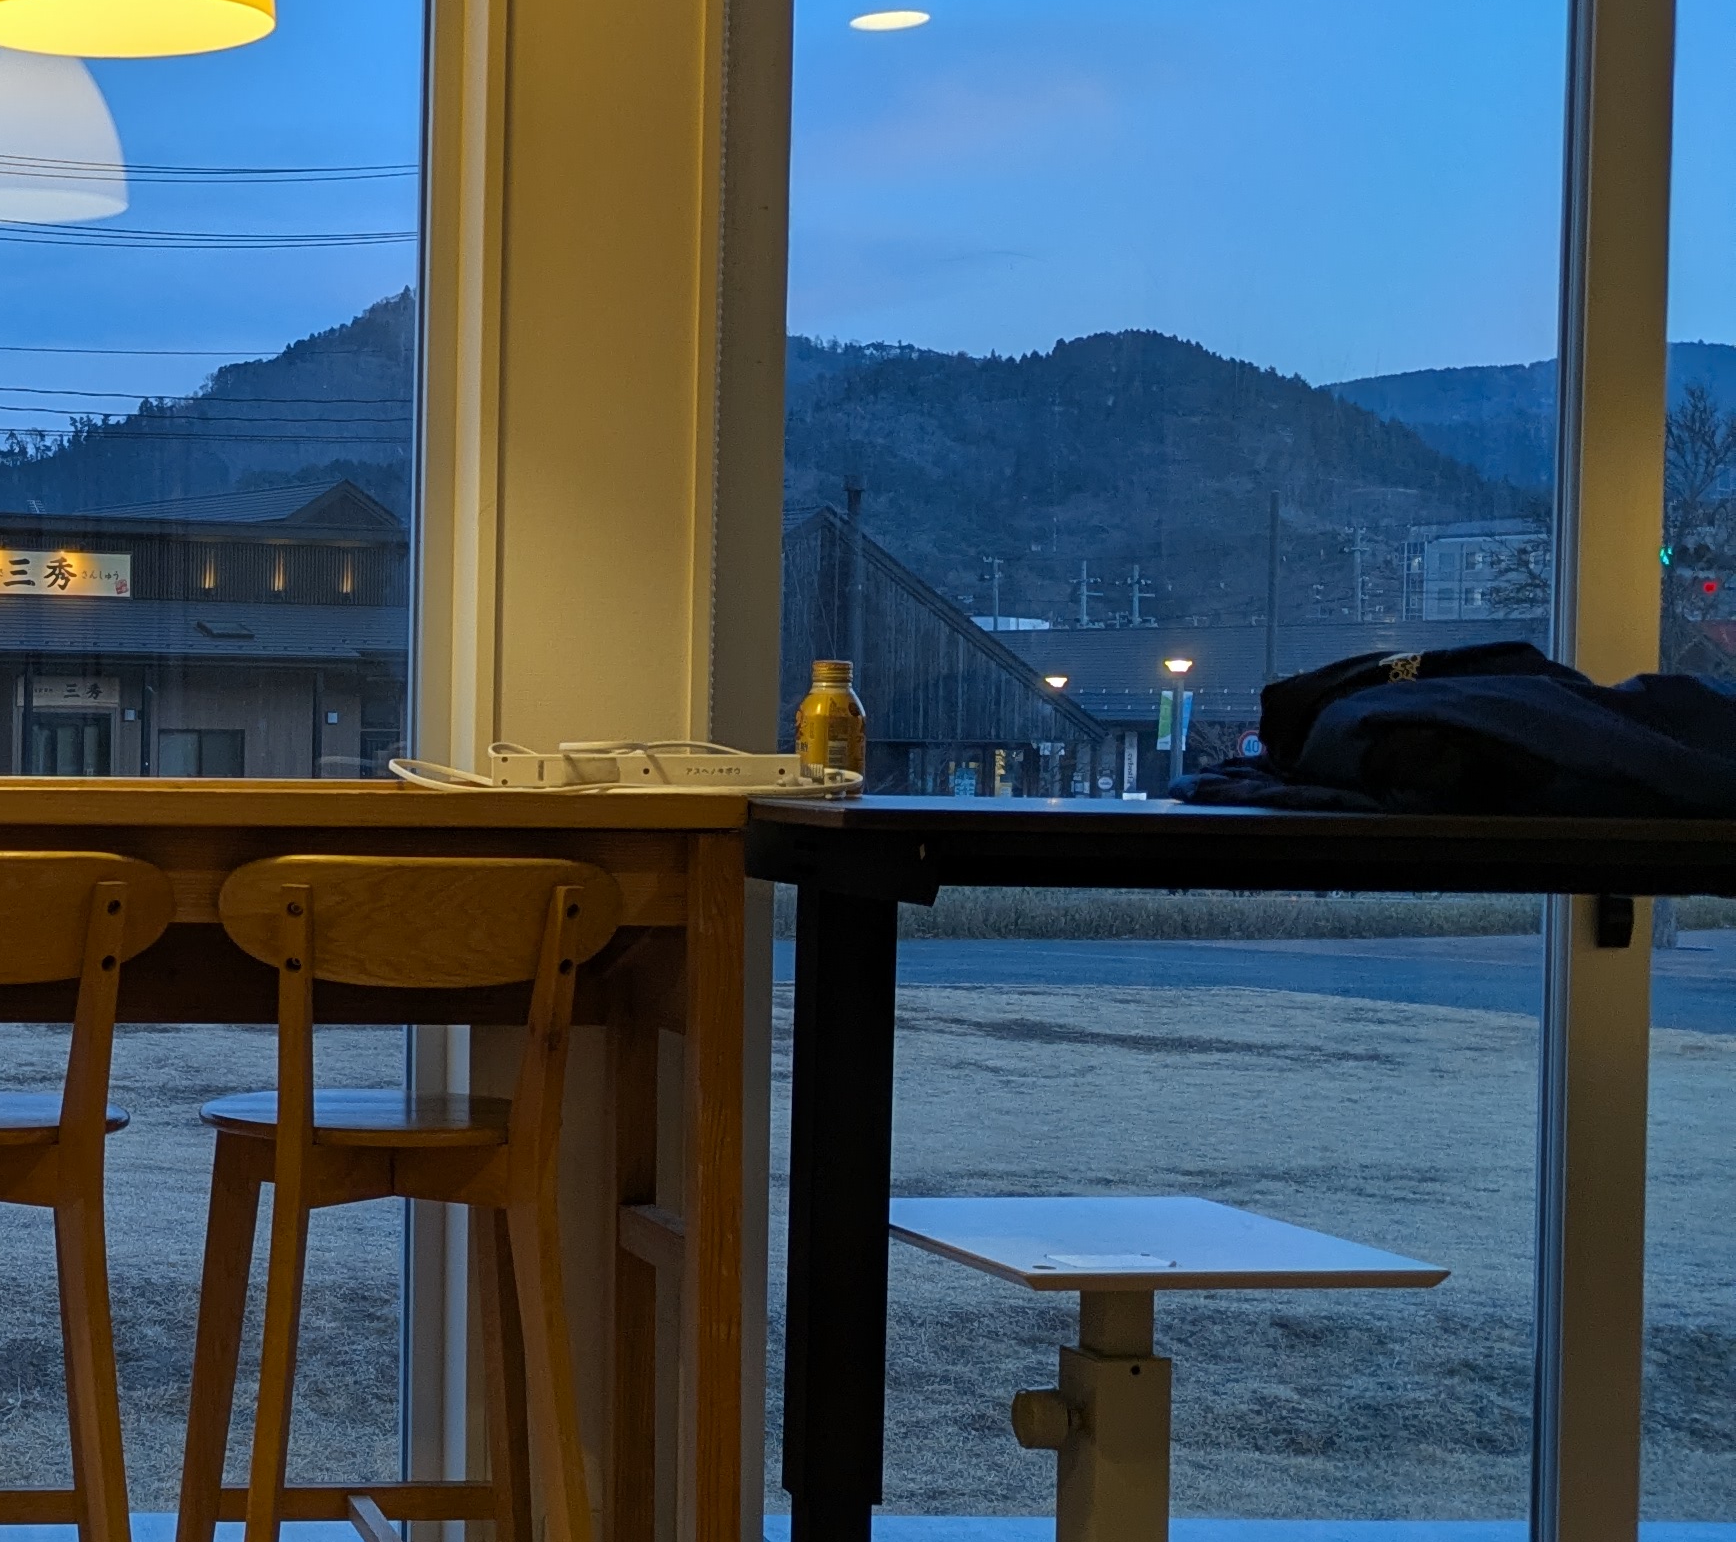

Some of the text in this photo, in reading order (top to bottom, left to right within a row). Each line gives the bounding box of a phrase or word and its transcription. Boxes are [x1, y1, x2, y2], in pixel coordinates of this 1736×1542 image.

[3, 556, 77, 591] 三秀
[81, 569, 120, 581] さんしゅう
[63, 683, 103, 700] 三秀
[1245, 739, 1260, 753] 40
